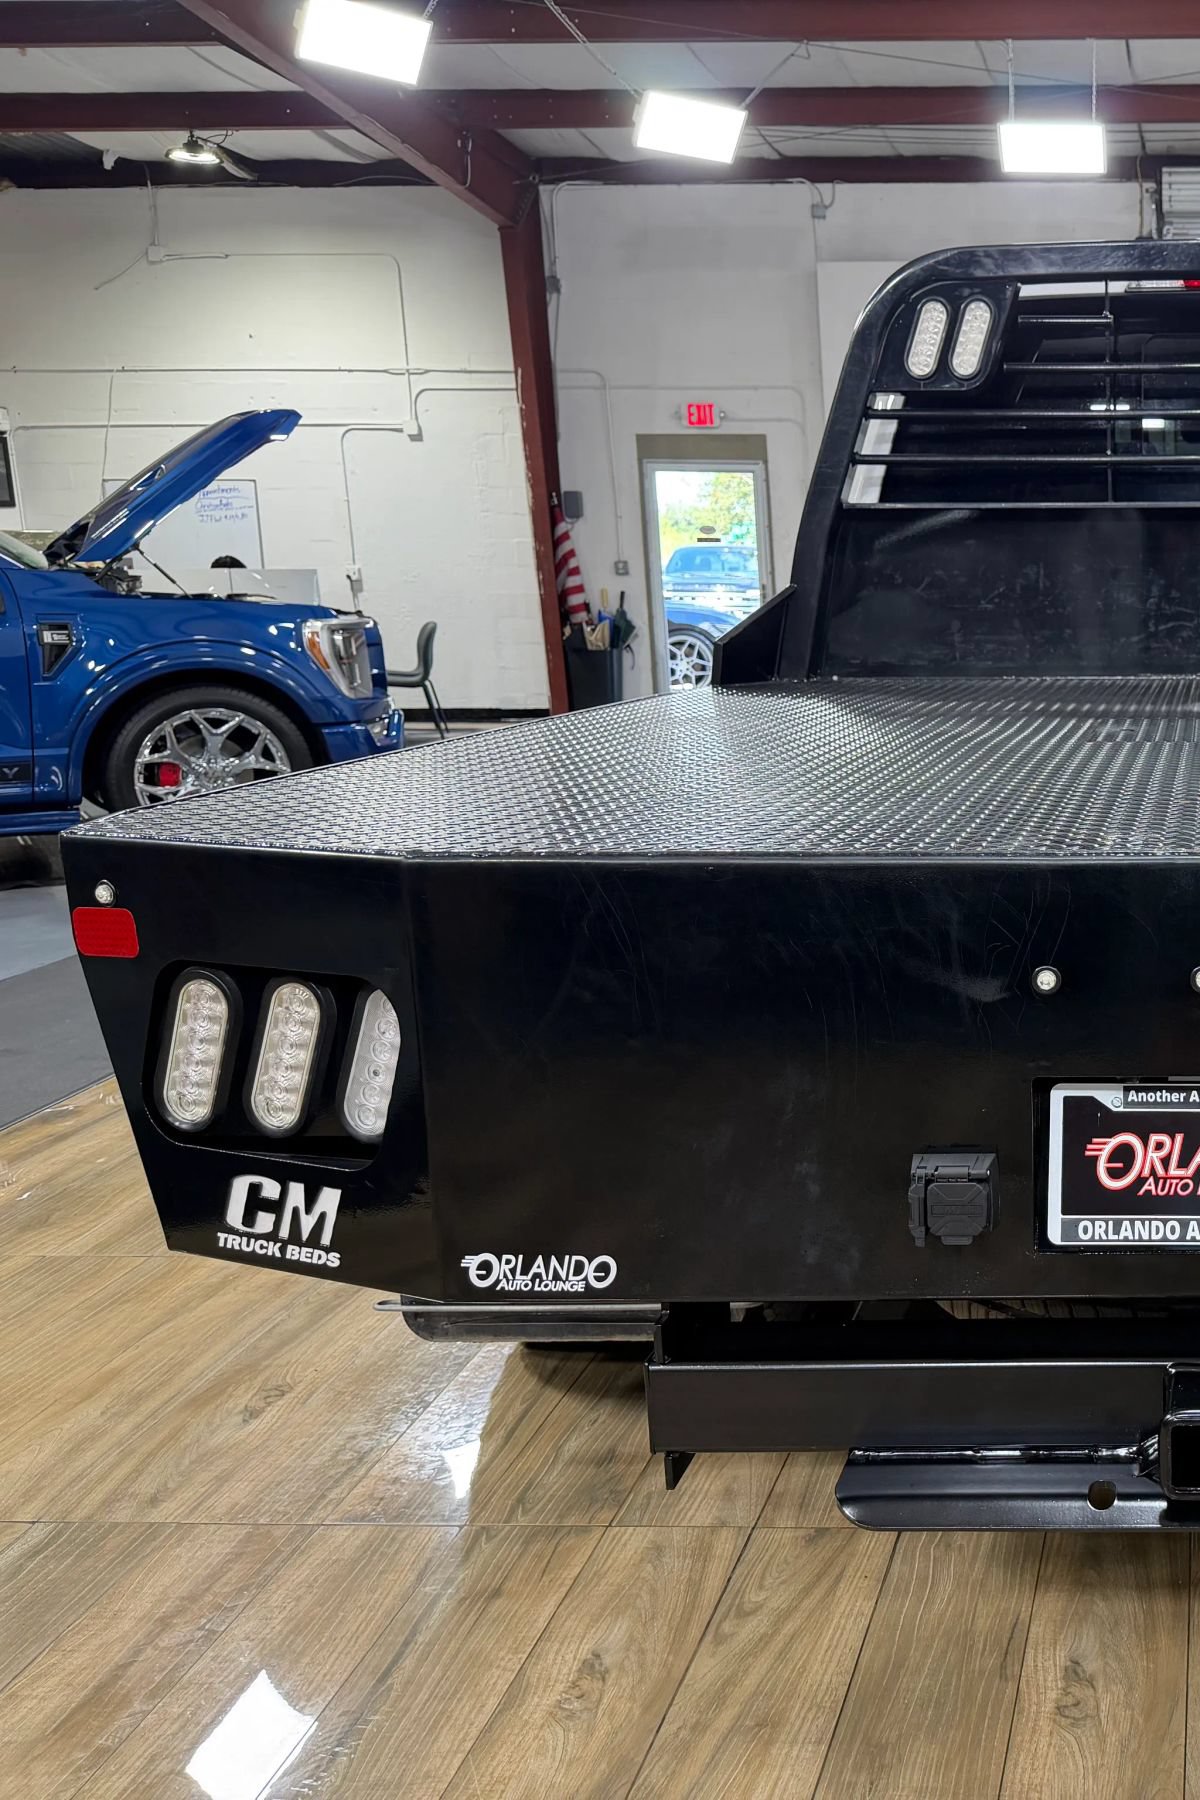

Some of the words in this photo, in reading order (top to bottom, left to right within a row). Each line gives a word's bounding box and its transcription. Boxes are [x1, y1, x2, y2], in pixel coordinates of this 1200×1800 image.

[687, 403, 714, 425] EXIT
[1127, 1089, 1187, 1104] Another
[225, 1174, 342, 1248] CM
[1077, 1219, 1181, 1241] ORLANDO
[217, 1231, 283, 1258] TRUCK
[285, 1244, 342, 1268] BEDS
[464, 1252, 618, 1288] ORLANDO
